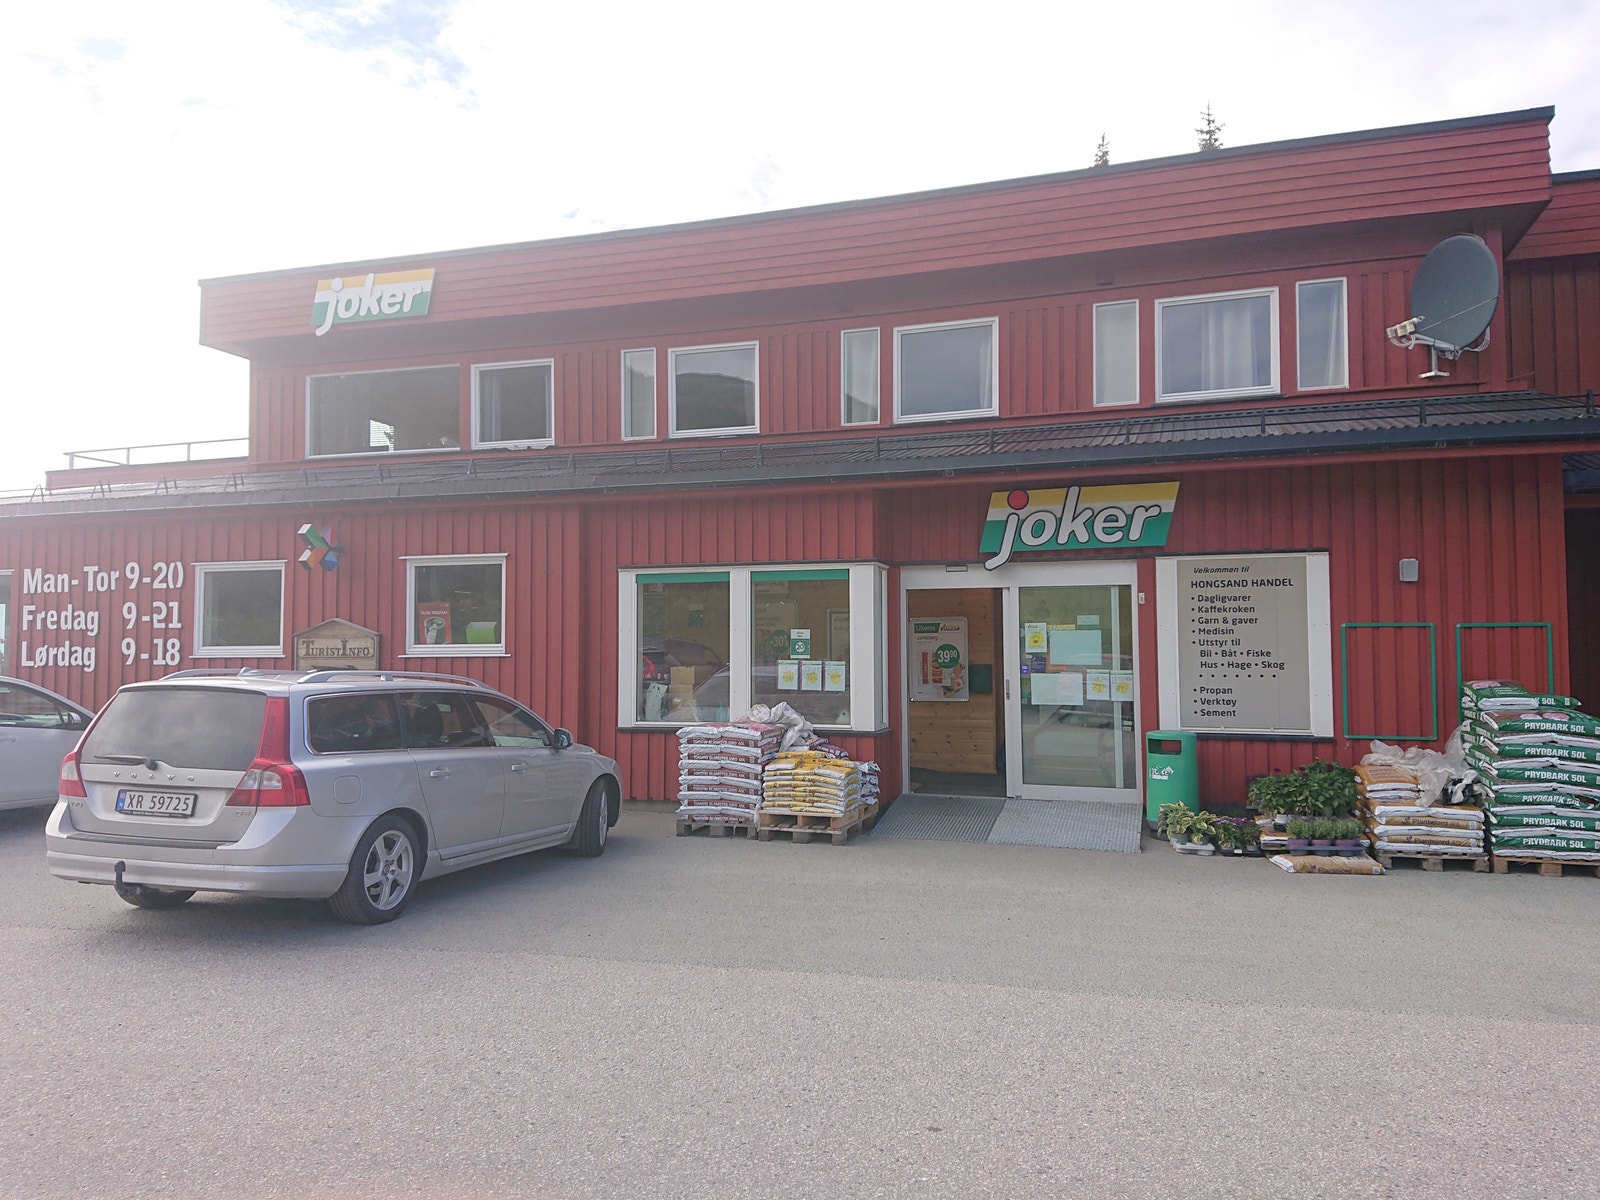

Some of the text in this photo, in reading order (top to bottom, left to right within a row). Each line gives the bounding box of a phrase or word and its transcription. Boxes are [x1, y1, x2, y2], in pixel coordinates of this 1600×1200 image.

[315, 272, 423, 337] joker
[983, 485, 1162, 572] joker
[1193, 565, 1250, 574] Velkommen til
[125, 561, 184, 590] 9-20
[1190, 578, 1294, 589] HONGSAND HANDEL
[1197, 594, 1252, 604] Dagligvarer
[1197, 605, 1255, 613] Kaffekroken
[22, 601, 182, 637] Fredag 9-21
[1197, 616, 1259, 626] Garn & gaver
[1198, 627, 1235, 635] Medisin
[1198, 638, 1241, 648] Utstyr til
[21, 637, 181, 673] Lørdag 9-18
[1200, 648, 1272, 658] Bil Båt Fiske
[1200, 660, 1285, 670] Hus Hage Skog
[1199, 686, 1233, 696] Propan
[1200, 697, 1237, 708] Verktøy
[1541, 696, 1557, 706] 50L
[1200, 708, 1237, 717] Sement
[1524, 722, 1586, 734] PRYDBARK 50L
[1524, 747, 1587, 760] PRYDBARK 50L
[1524, 770, 1587, 784] PRYDBARK 50L
[127, 793, 191, 812] XR 59725
[1522, 794, 1566, 805] PRYDBARK
[1523, 817, 1586, 829] PRYDBARK 50L
[1522, 838, 1586, 849] PRYDBARK 50L
